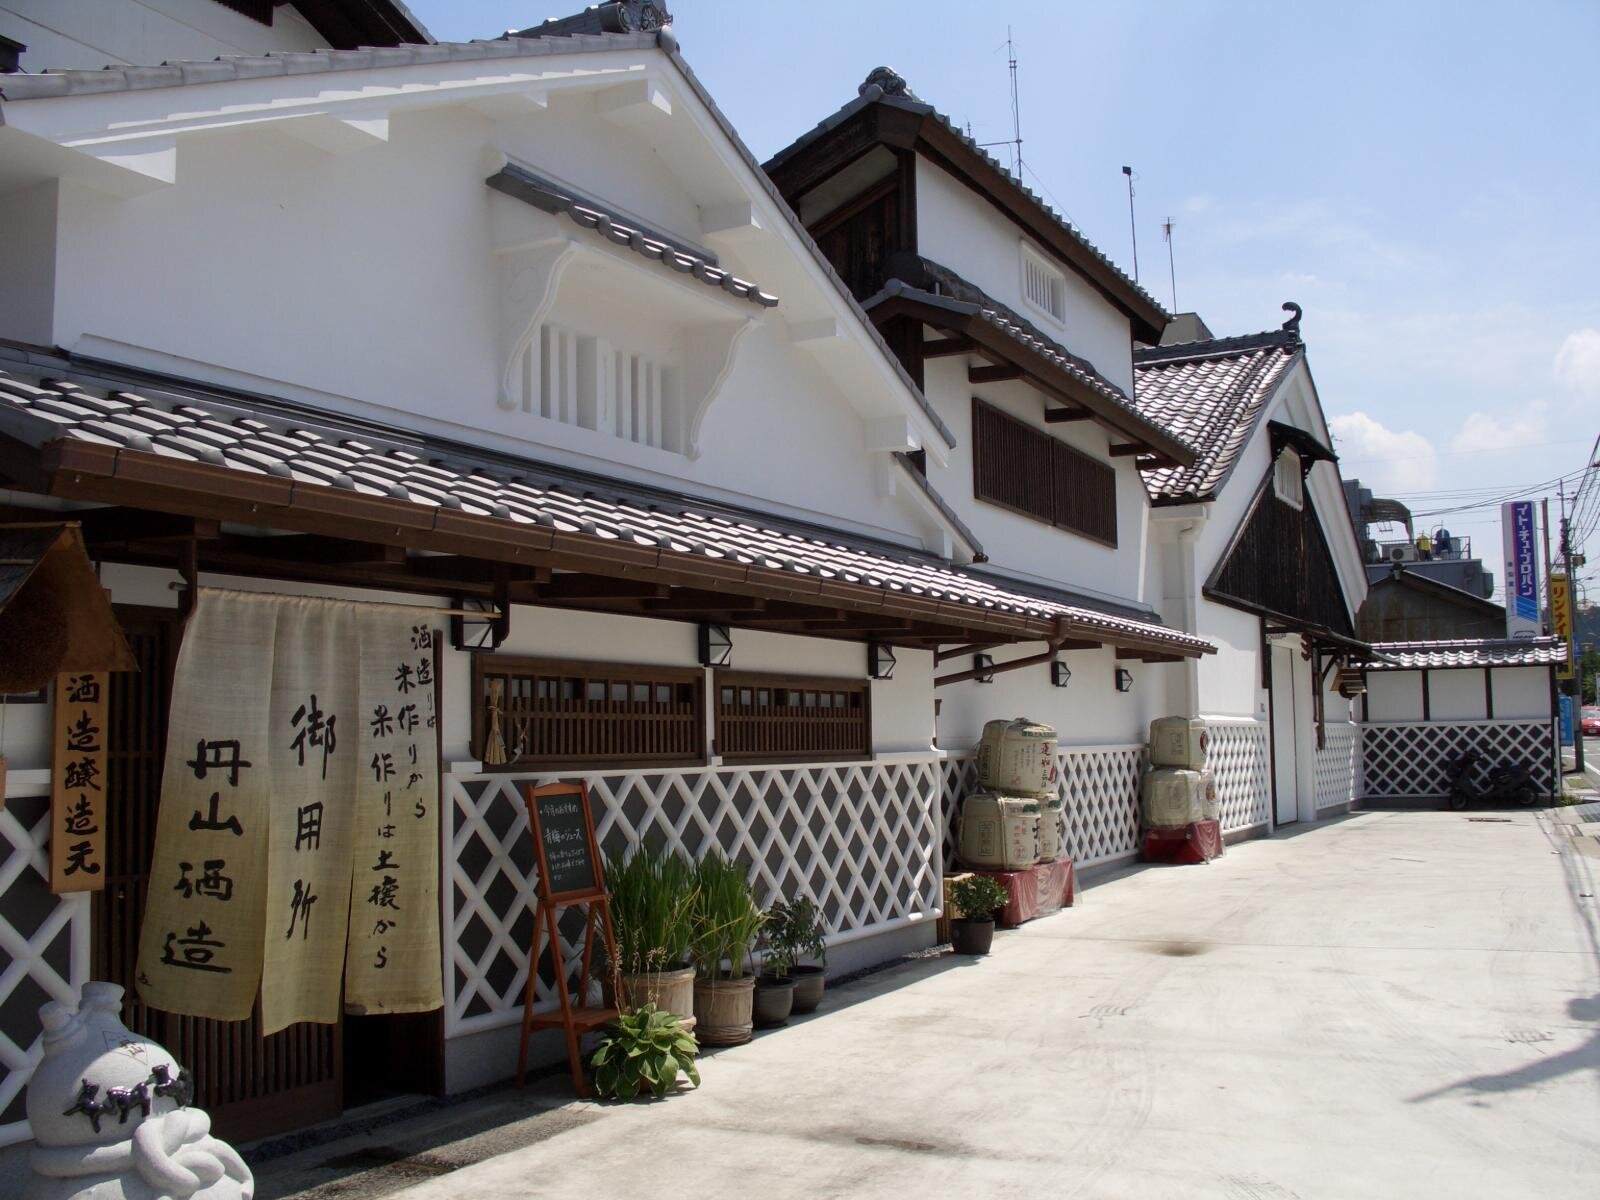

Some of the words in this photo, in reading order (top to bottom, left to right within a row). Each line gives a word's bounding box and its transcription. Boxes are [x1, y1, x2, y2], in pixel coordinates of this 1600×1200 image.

[394, 661, 427, 819] 米作りから
[159, 738, 252, 974] 丹山酒造
